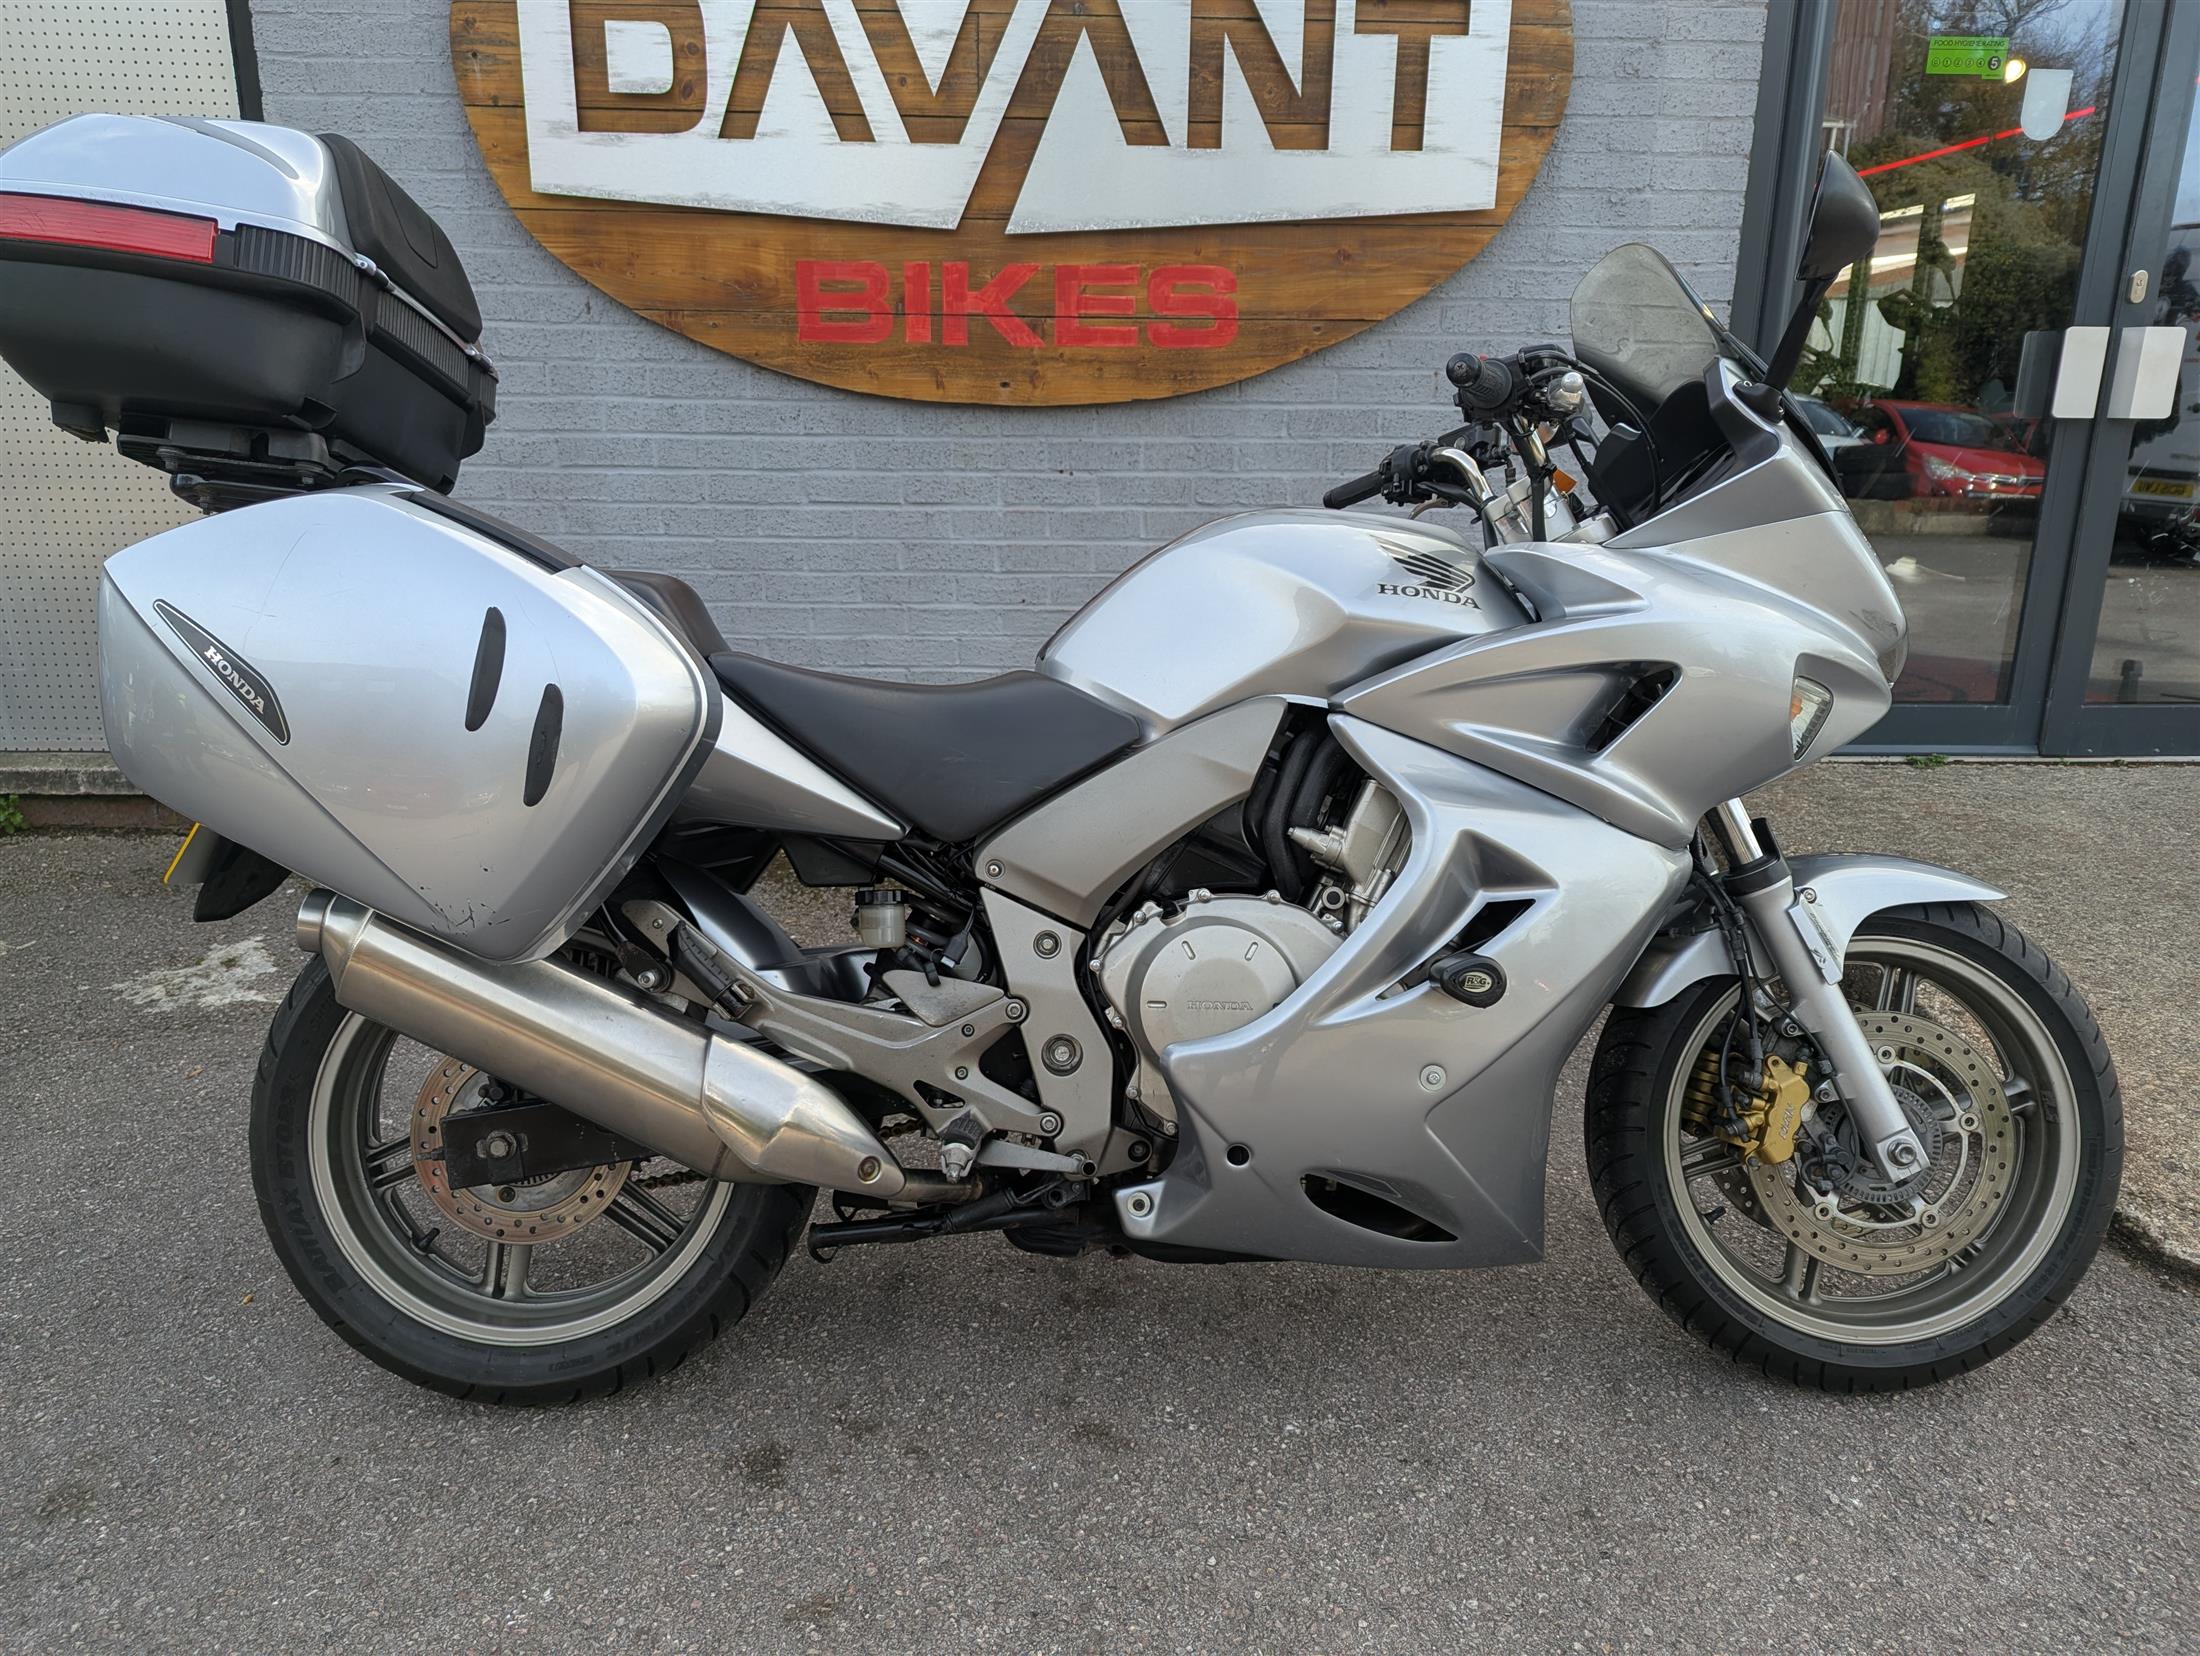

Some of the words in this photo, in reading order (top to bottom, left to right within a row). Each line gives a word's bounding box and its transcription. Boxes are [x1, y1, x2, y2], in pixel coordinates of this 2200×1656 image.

[1934, 39, 1954, 47] FOOD
[1983, 40, 2006, 48] RATING
[1990, 57, 1999, 69] 5
[569, 0, 1471, 233] DAVANT
[795, 260, 1239, 348] BIKES
[1377, 583, 1482, 610] HONDA
[203, 645, 265, 714] HONDA
[1466, 976, 1488, 985] R&G
[1186, 1000, 1254, 1011] HONDA
